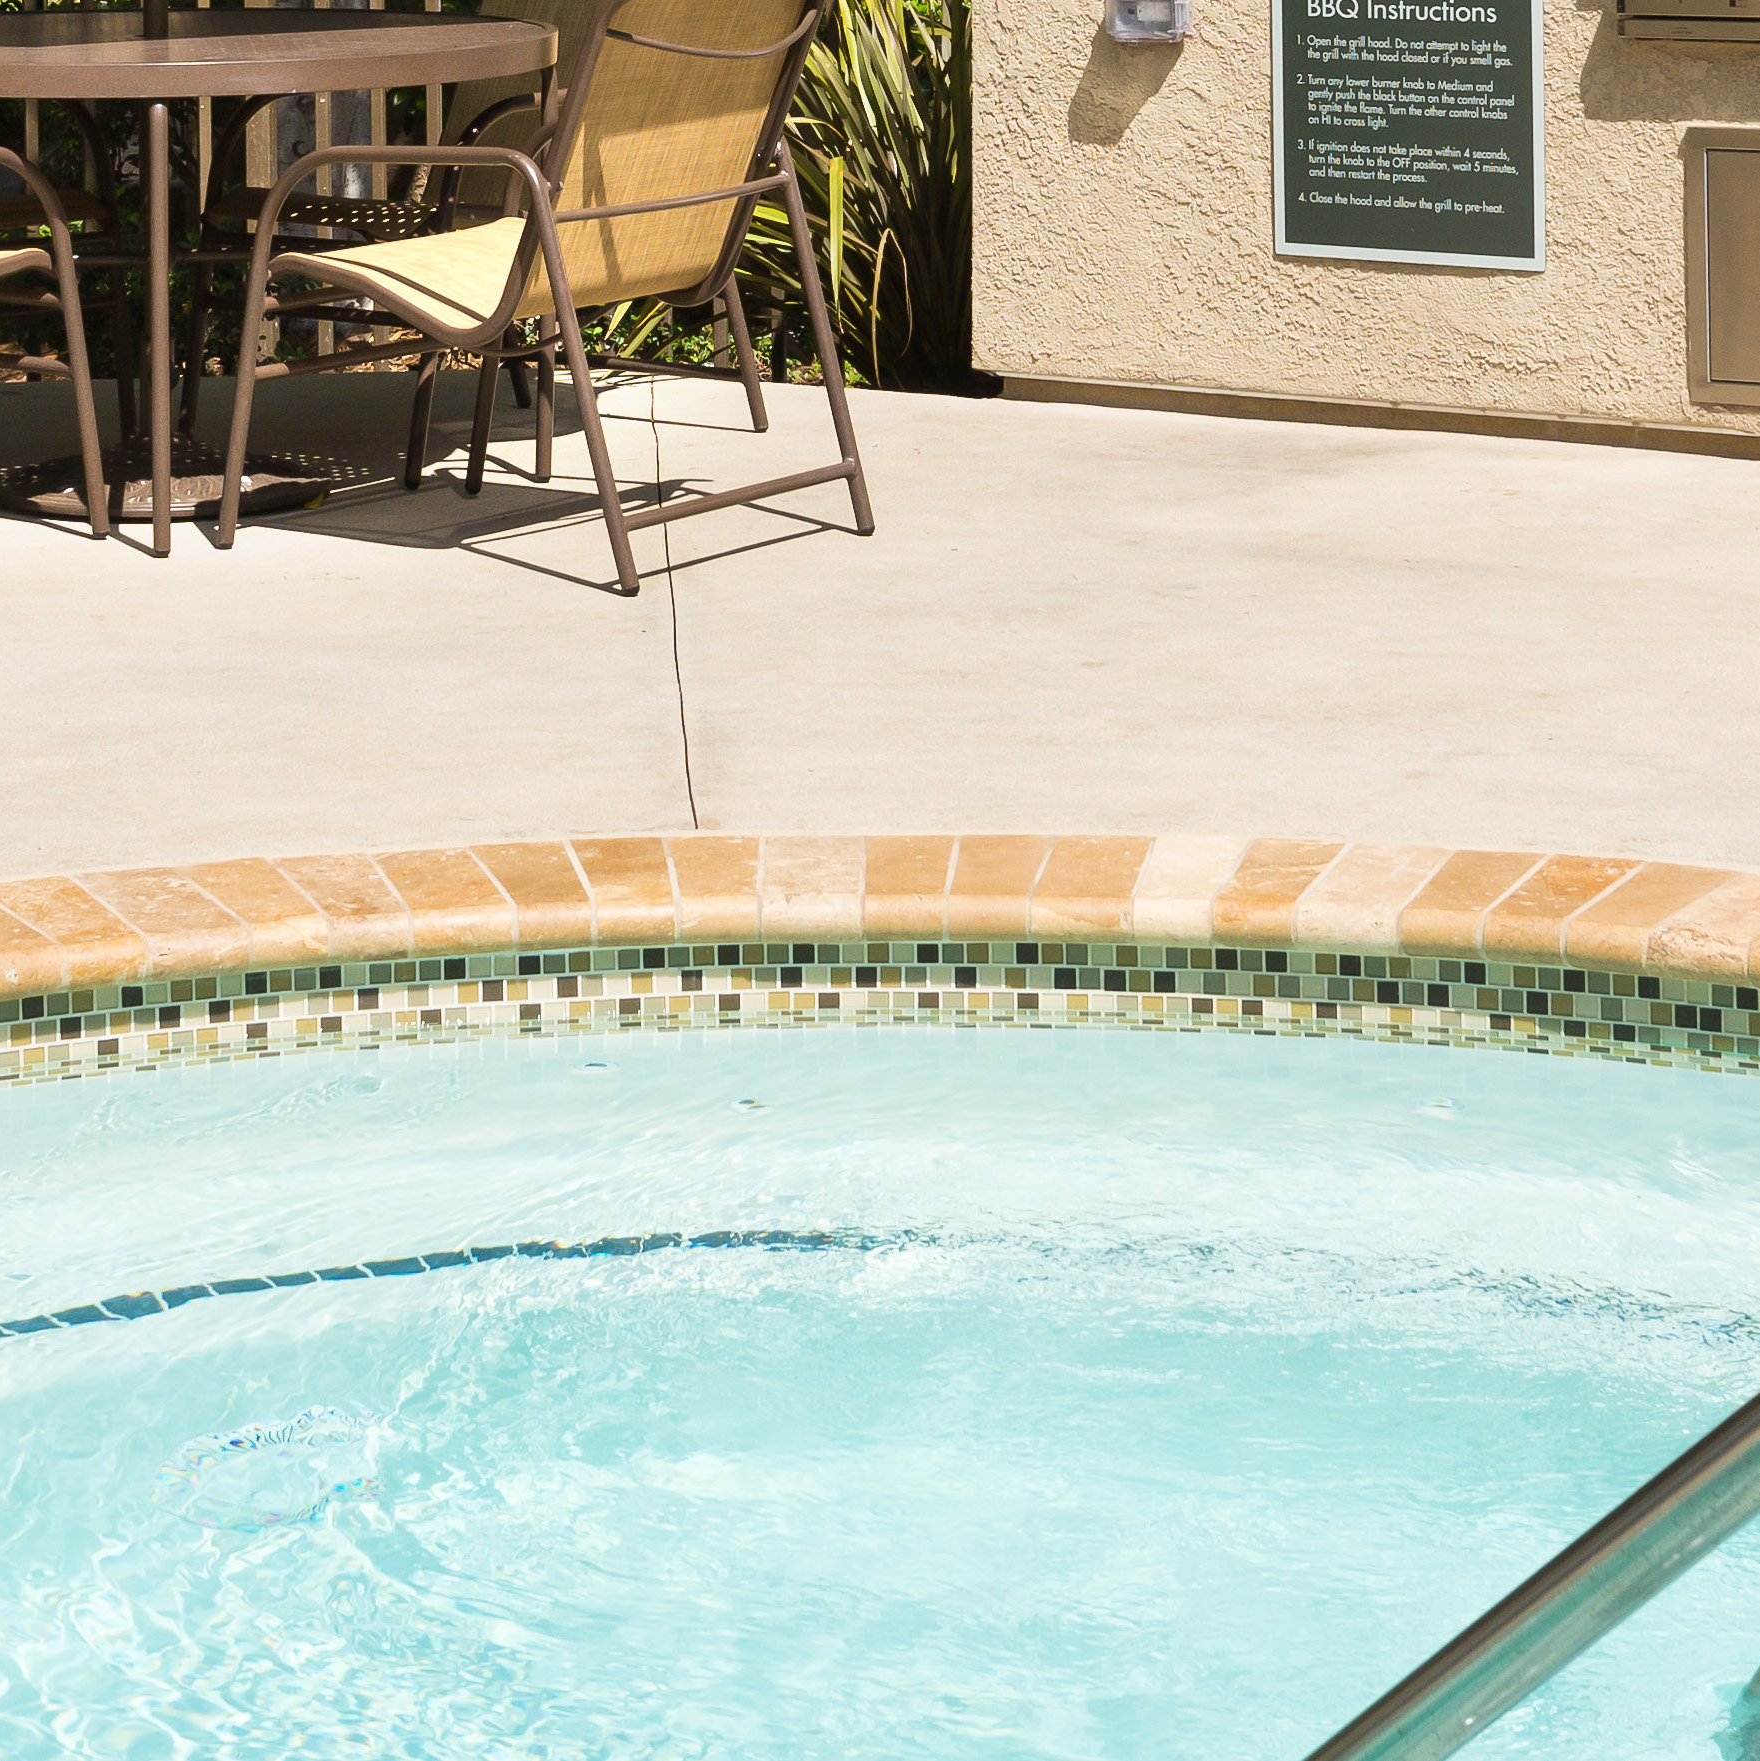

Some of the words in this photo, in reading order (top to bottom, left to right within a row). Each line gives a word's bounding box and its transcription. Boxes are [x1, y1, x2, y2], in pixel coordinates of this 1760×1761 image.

[1306, 34, 1332, 49] Open
[1333, 34, 1347, 46] the
[1348, 35, 1366, 50] grill
[1367, 36, 1393, 48] hood.
[1394, 37, 1409, 48] Do
[1409, 40, 1425, 49] not
[1460, 41, 1470, 51] to
[1471, 39, 1492, 55] light
[1492, 40, 1507, 52] the
[1307, 47, 1321, 58] the
[1322, 47, 1339, 62] grill
[1340, 48, 1360, 60] with
[1361, 49, 1375, 61] the
[1376, 49, 1400, 61] hood
[1400, 50, 1429, 63] closed
[1430, 55, 1441, 63] or
[1442, 52, 1450, 63] if
[1450, 56, 1468, 67] you
[1469, 53, 1492, 65] smell
[1493, 57, 1513, 69] gas.
[1307, 73, 1326, 85] Turn
[1326, 78, 1345, 89] any
[1345, 74, 1370, 87] lower
[1371, 75, 1401, 88] burner
[1402, 76, 1425, 89] knob
[1426, 80, 1436, 90] to
[1437, 78, 1474, 91] Medium
[1475, 79, 1494, 92] and
[1335, 89, 1356, 104] push
[1357, 89, 1372, 100] the
[1372, 90, 1397, 101] black
[1398, 91, 1426, 102] button
[1427, 95, 1440, 103] on
[1441, 92, 1456, 104] the
[1456, 92, 1488, 105] control
[1489, 93, 1515, 109] panel
[1307, 102, 1317, 111] to
[1343, 101, 1358, 113] the
[1359, 102, 1386, 114] flame.
[1388, 103, 1407, 115] Turn
[1408, 104, 1423, 116] the
[1423, 104, 1447, 117] other
[1448, 105, 1480, 118] control
[1481, 106, 1508, 119] knobs
[1307, 116, 1320, 124] on
[1321, 113, 1332, 124] HI
[1333, 115, 1342, 125] to
[1343, 118, 1366, 126] cross
[1367, 115, 1389, 130] light.
[1316, 140, 1349, 155] ignition
[1349, 140, 1371, 153] does
[1372, 144, 1387, 153] not
[1388, 142, 1407, 155] take
[1408, 143, 1433, 159] place
[1434, 144, 1462, 157] within
[1463, 147, 1471, 157] 4
[1472, 146, 1511, 161] seconds,
[1308, 154, 1326, 163] turn
[1327, 153, 1341, 165] the
[1342, 154, 1365, 166] knob
[1366, 157, 1376, 166] to
[1376, 155, 1391, 167] the
[1391, 156, 1411, 168] OFF
[1413, 158, 1450, 173] position,
[1451, 160, 1472, 171] wait
[1473, 160, 1481, 172] 5
[1308, 164, 1326, 177] and
[1327, 165, 1346, 178] then
[1348, 169, 1376, 179] restart
[1376, 168, 1391, 180] the
[1392, 173, 1428, 185] process.
[1309, 191, 1333, 203] Close
[1334, 192, 1349, 204] the
[1349, 193, 1373, 206] hood
[1373, 194, 1392, 207] and
[1393, 195, 1418, 208] allow
[1418, 197, 1433, 209] the
[1434, 197, 1452, 213] grill
[1453, 201, 1463, 211] to
[1464, 199, 1505, 216] pre-heat.
